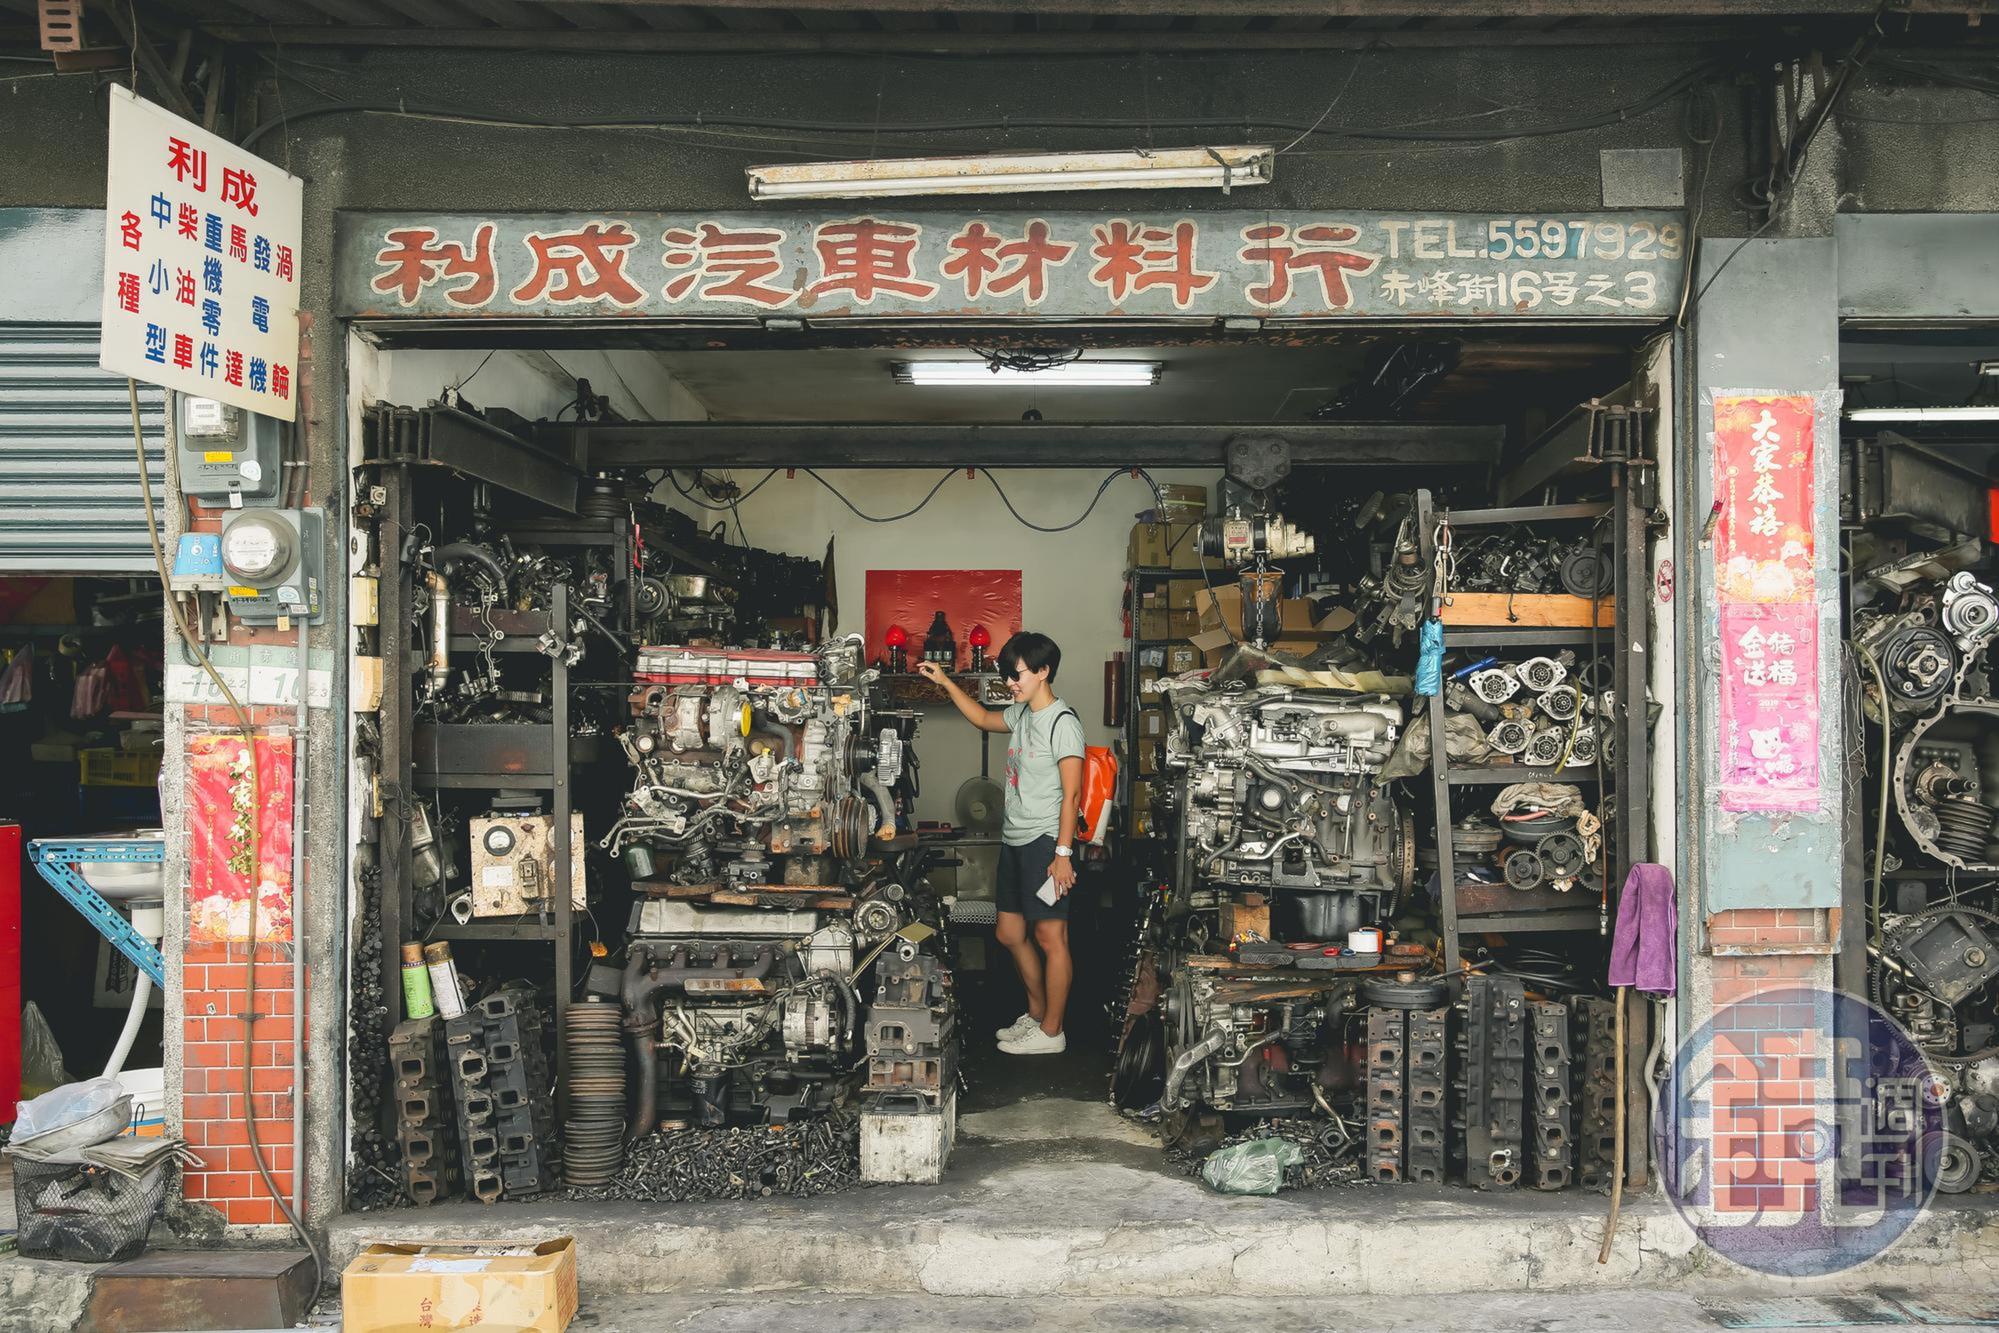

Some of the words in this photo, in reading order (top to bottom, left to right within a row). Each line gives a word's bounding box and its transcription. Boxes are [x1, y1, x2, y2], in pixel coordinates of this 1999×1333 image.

[167, 136, 258, 217] 利成
[117, 210, 143, 314] 各種
[145, 191, 173, 364] 中小型
[172, 202, 199, 370] 柴油車
[199, 212, 224, 379] 重機零件
[224, 224, 248, 388] 馬達
[248, 234, 271, 393] 發電機
[271, 243, 294, 401] 渦輪
[371, 219, 1381, 309] 利成汽車材料行
[1742, 658, 1798, 688] 送福
